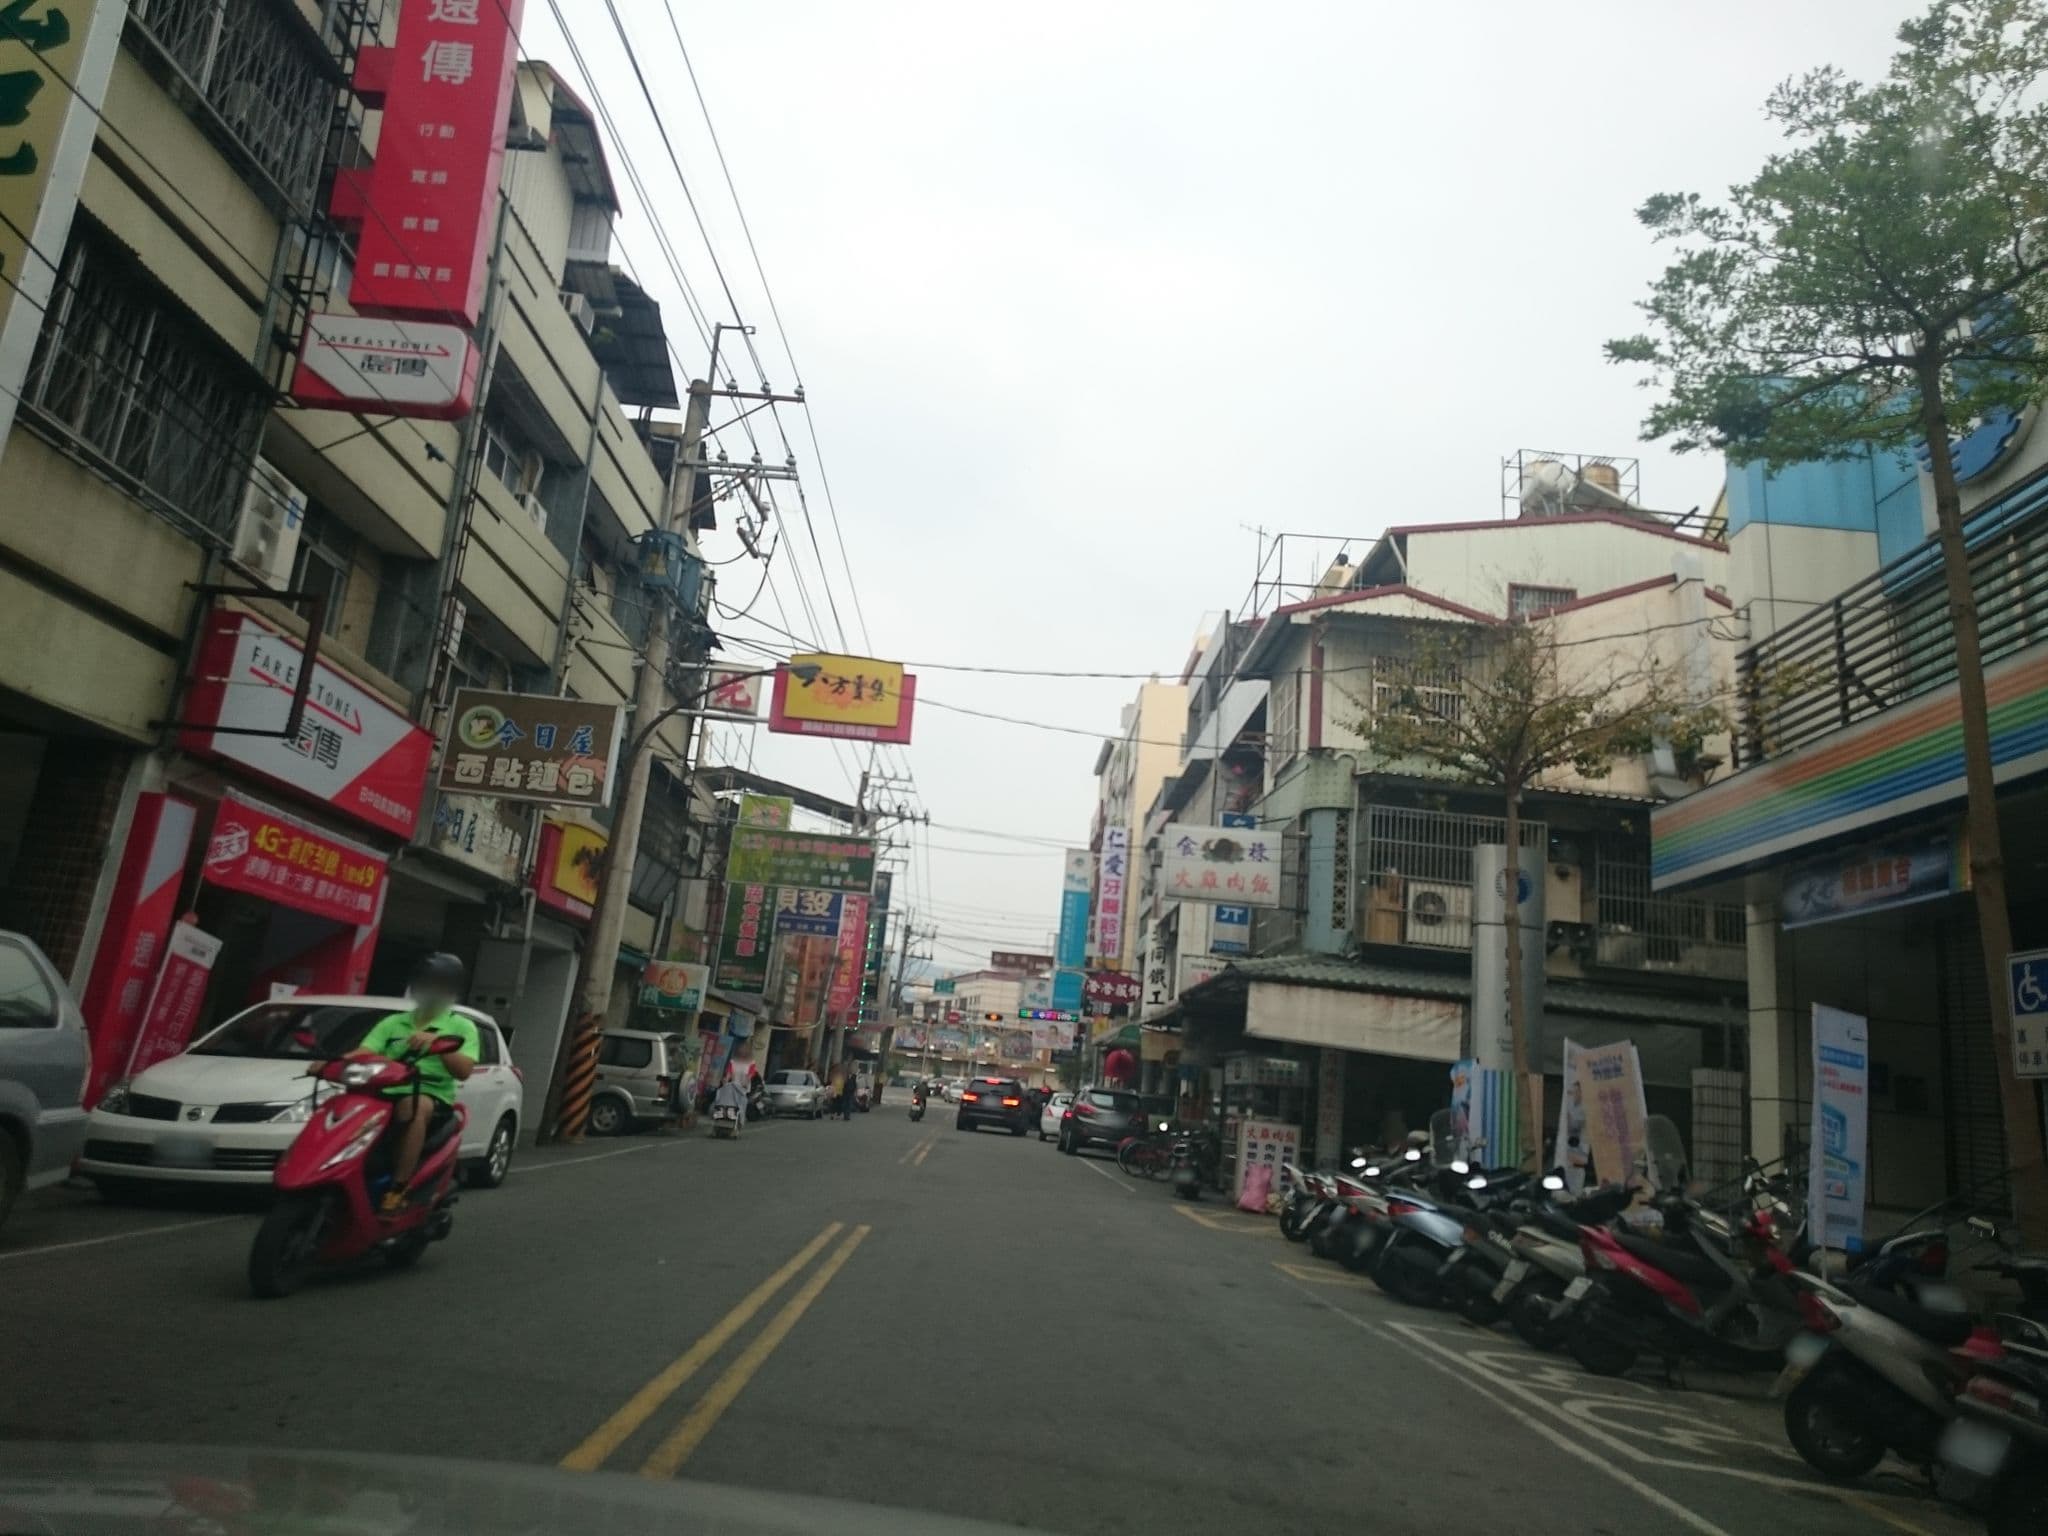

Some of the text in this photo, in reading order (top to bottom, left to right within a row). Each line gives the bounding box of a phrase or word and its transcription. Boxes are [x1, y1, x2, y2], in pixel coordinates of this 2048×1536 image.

[495, 719, 594, 756] 今日屋
[1099, 829, 1124, 954] 仁愛牙醫診所
